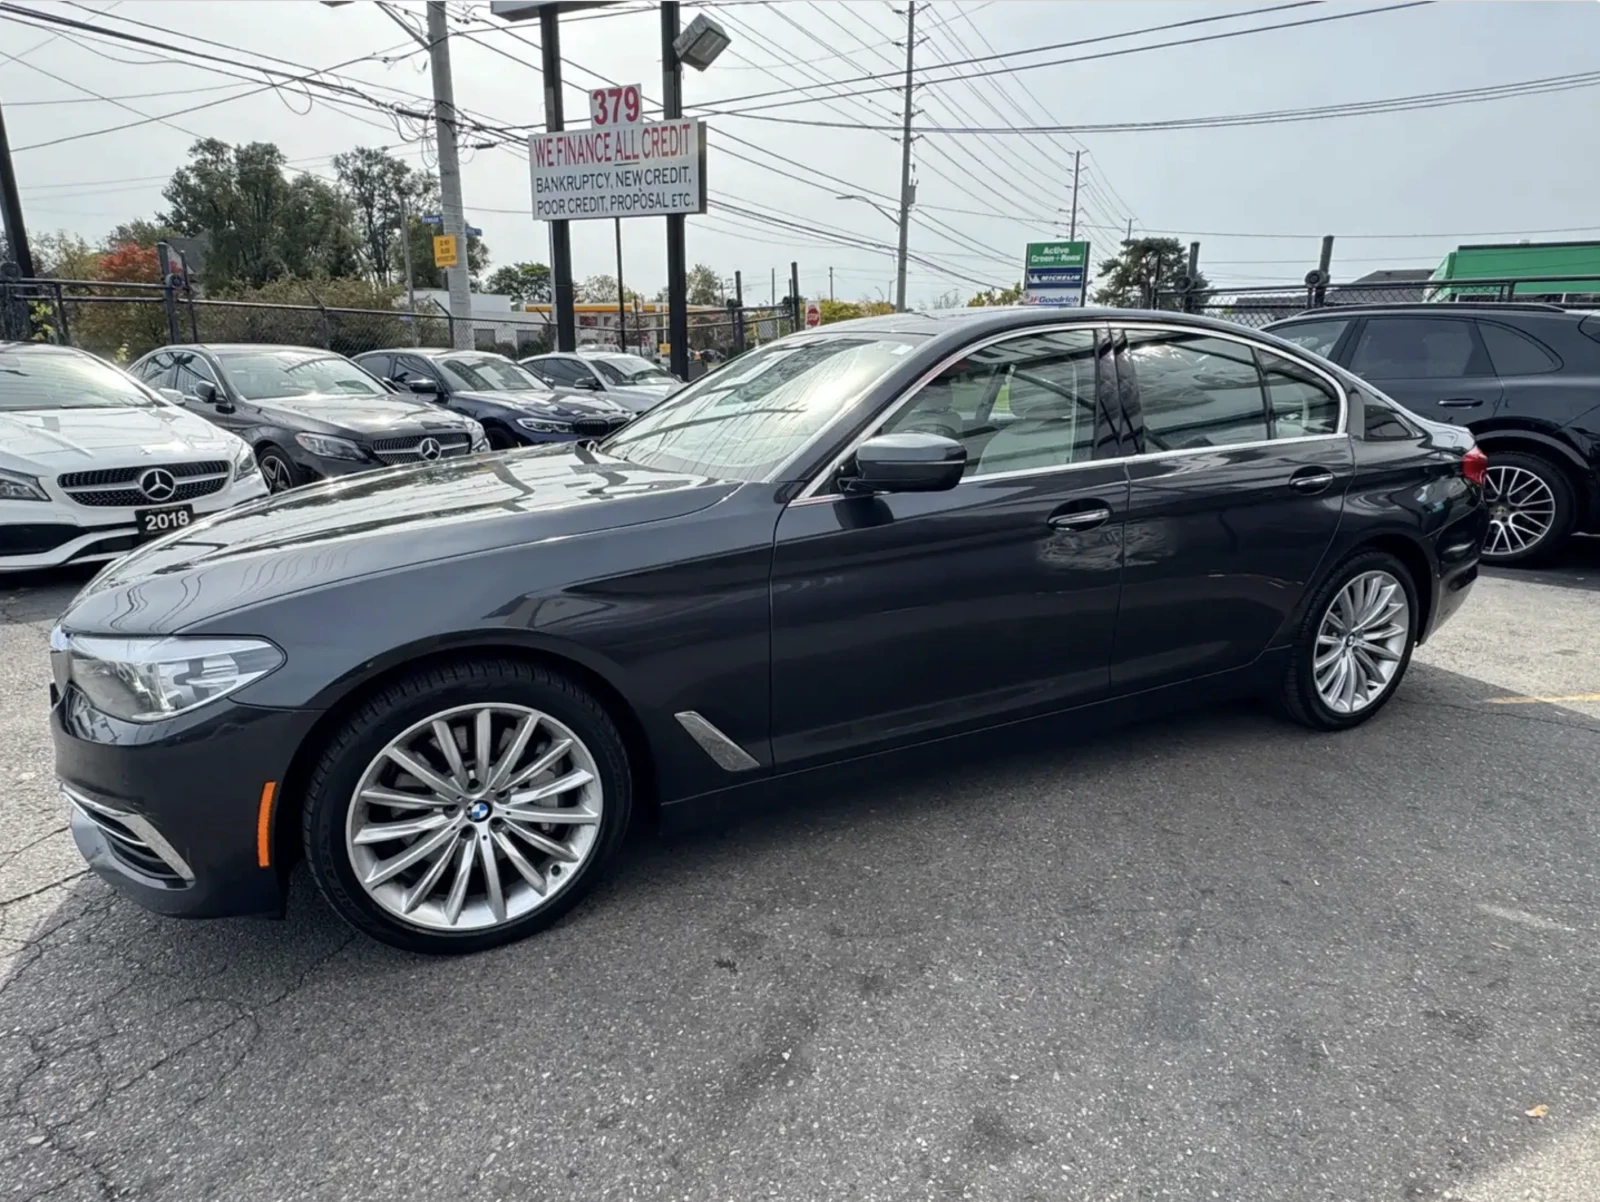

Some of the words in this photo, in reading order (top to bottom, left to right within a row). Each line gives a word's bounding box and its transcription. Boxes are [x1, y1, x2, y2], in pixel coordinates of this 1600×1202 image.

[592, 86, 640, 125] 379
[534, 138, 555, 168] WE
[556, 132, 612, 166] FINANCE
[614, 129, 640, 161] ALL
[641, 123, 691, 159] CREDIT
[536, 172, 614, 193] BANKRUPTCY,
[615, 169, 643, 187] NEW
[644, 166, 692, 186] CREDIT,
[537, 199, 566, 215] POOR
[567, 195, 609, 214] CREDIT,
[610, 192, 669, 211] PROPOSAL
[145, 510, 190, 531] 2018
